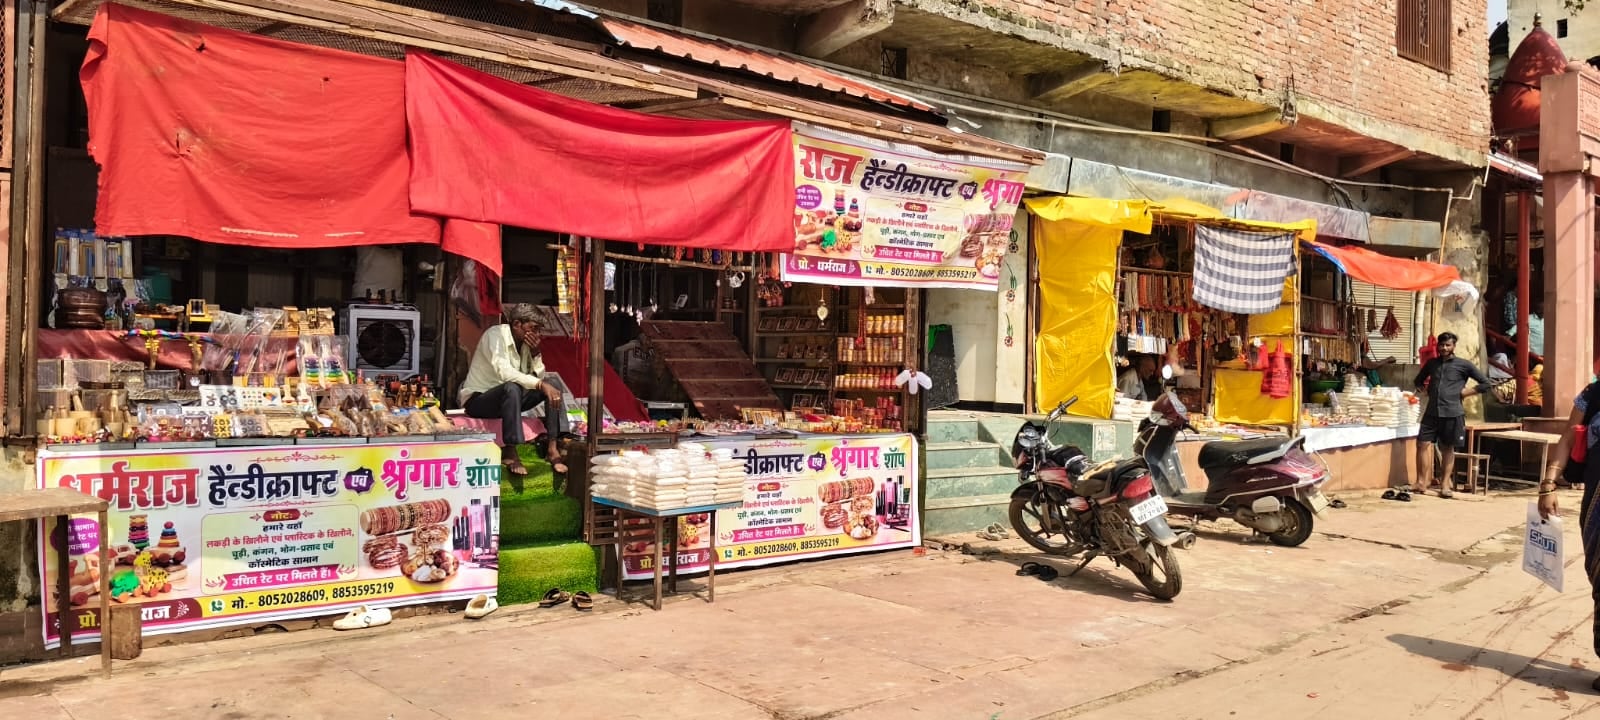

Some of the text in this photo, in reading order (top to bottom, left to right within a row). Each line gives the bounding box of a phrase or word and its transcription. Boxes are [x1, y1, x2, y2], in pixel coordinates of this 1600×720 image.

[817, 259, 846, 273] धर्मराज
[811, 454, 824, 467] एवं
[883, 447, 906, 468] शॉप
[351, 470, 368, 487] एवं
[465, 458, 501, 486] शॉप
[262, 522, 284, 532] हमारे
[206, 536, 230, 549] लकड़ी
[232, 535, 241, 546] के
[242, 533, 269, 545] खिलौने
[271, 532, 283, 543] एवं
[284, 531, 315, 542] प्लास्टिक
[317, 529, 325, 539] के
[322, 540, 334, 550] एवं
[248, 554, 319, 569] कॉस्मेटिक सामान
[232, 574, 257, 587] उचित
[260, 572, 272, 584] रेट
[275, 571, 288, 583] पर
[291, 568, 318, 581] मिलते
[332, 581, 394, 599] 8853595219
